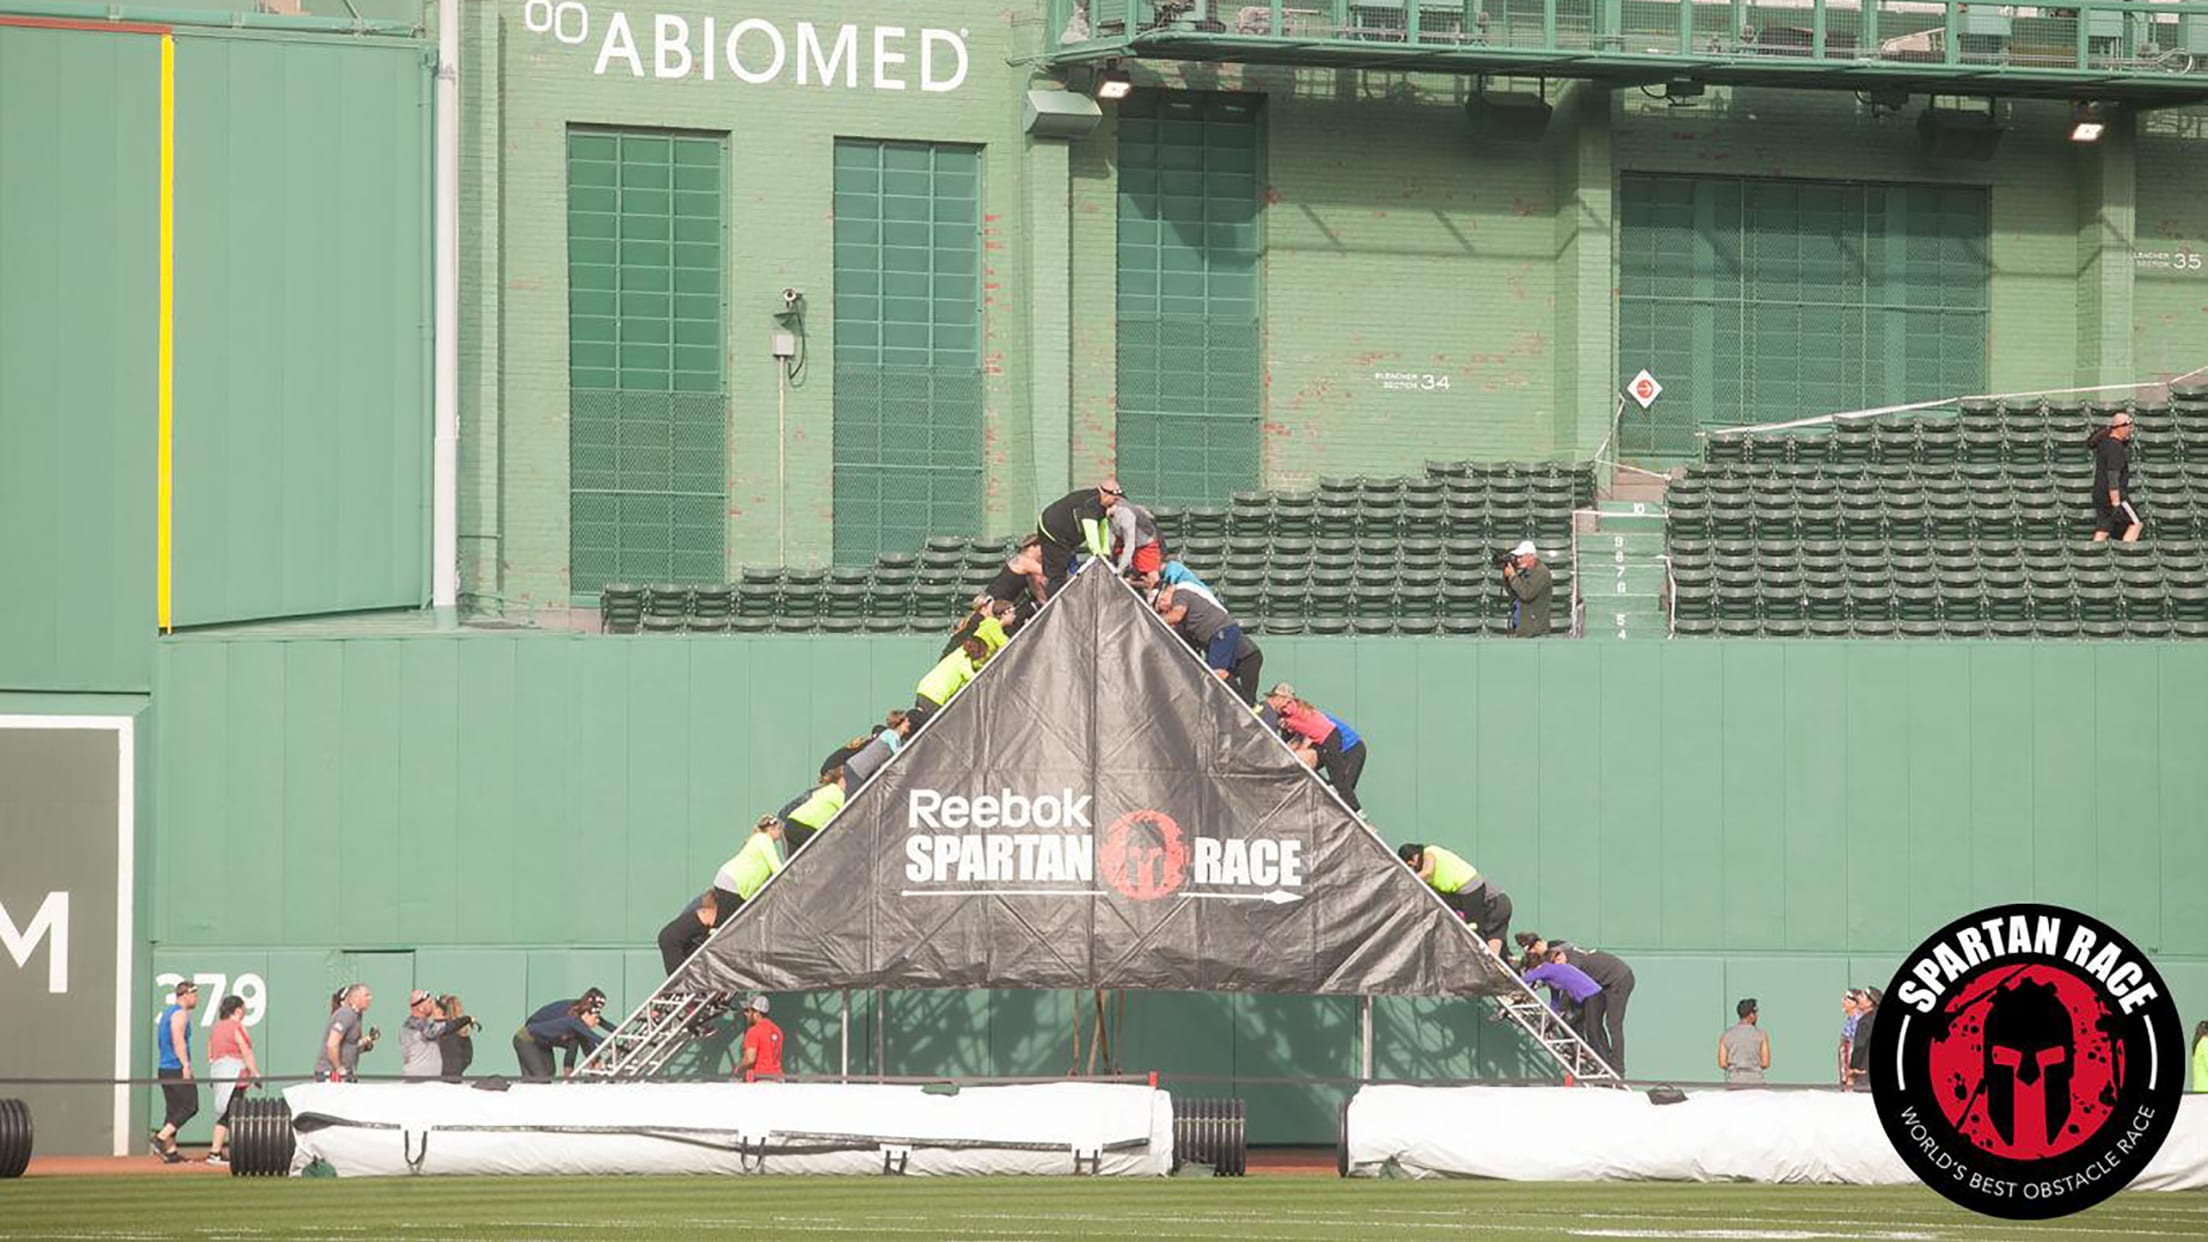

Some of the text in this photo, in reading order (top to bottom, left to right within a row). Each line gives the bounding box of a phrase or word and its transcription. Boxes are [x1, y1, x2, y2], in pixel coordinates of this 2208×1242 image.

[594, 12, 968, 92] ABIOMED
[2173, 253, 2202, 269] 35
[1421, 374, 1451, 390] 34
[1633, 503, 1645, 513] 10
[1614, 536, 1623, 547] 9
[1616, 566, 1625, 577] 7
[1616, 614, 1626, 626] 5
[1618, 629, 1626, 639] 4
[908, 788, 1093, 829] Reebok
[905, 835, 1301, 887] SPARTAN RACE
